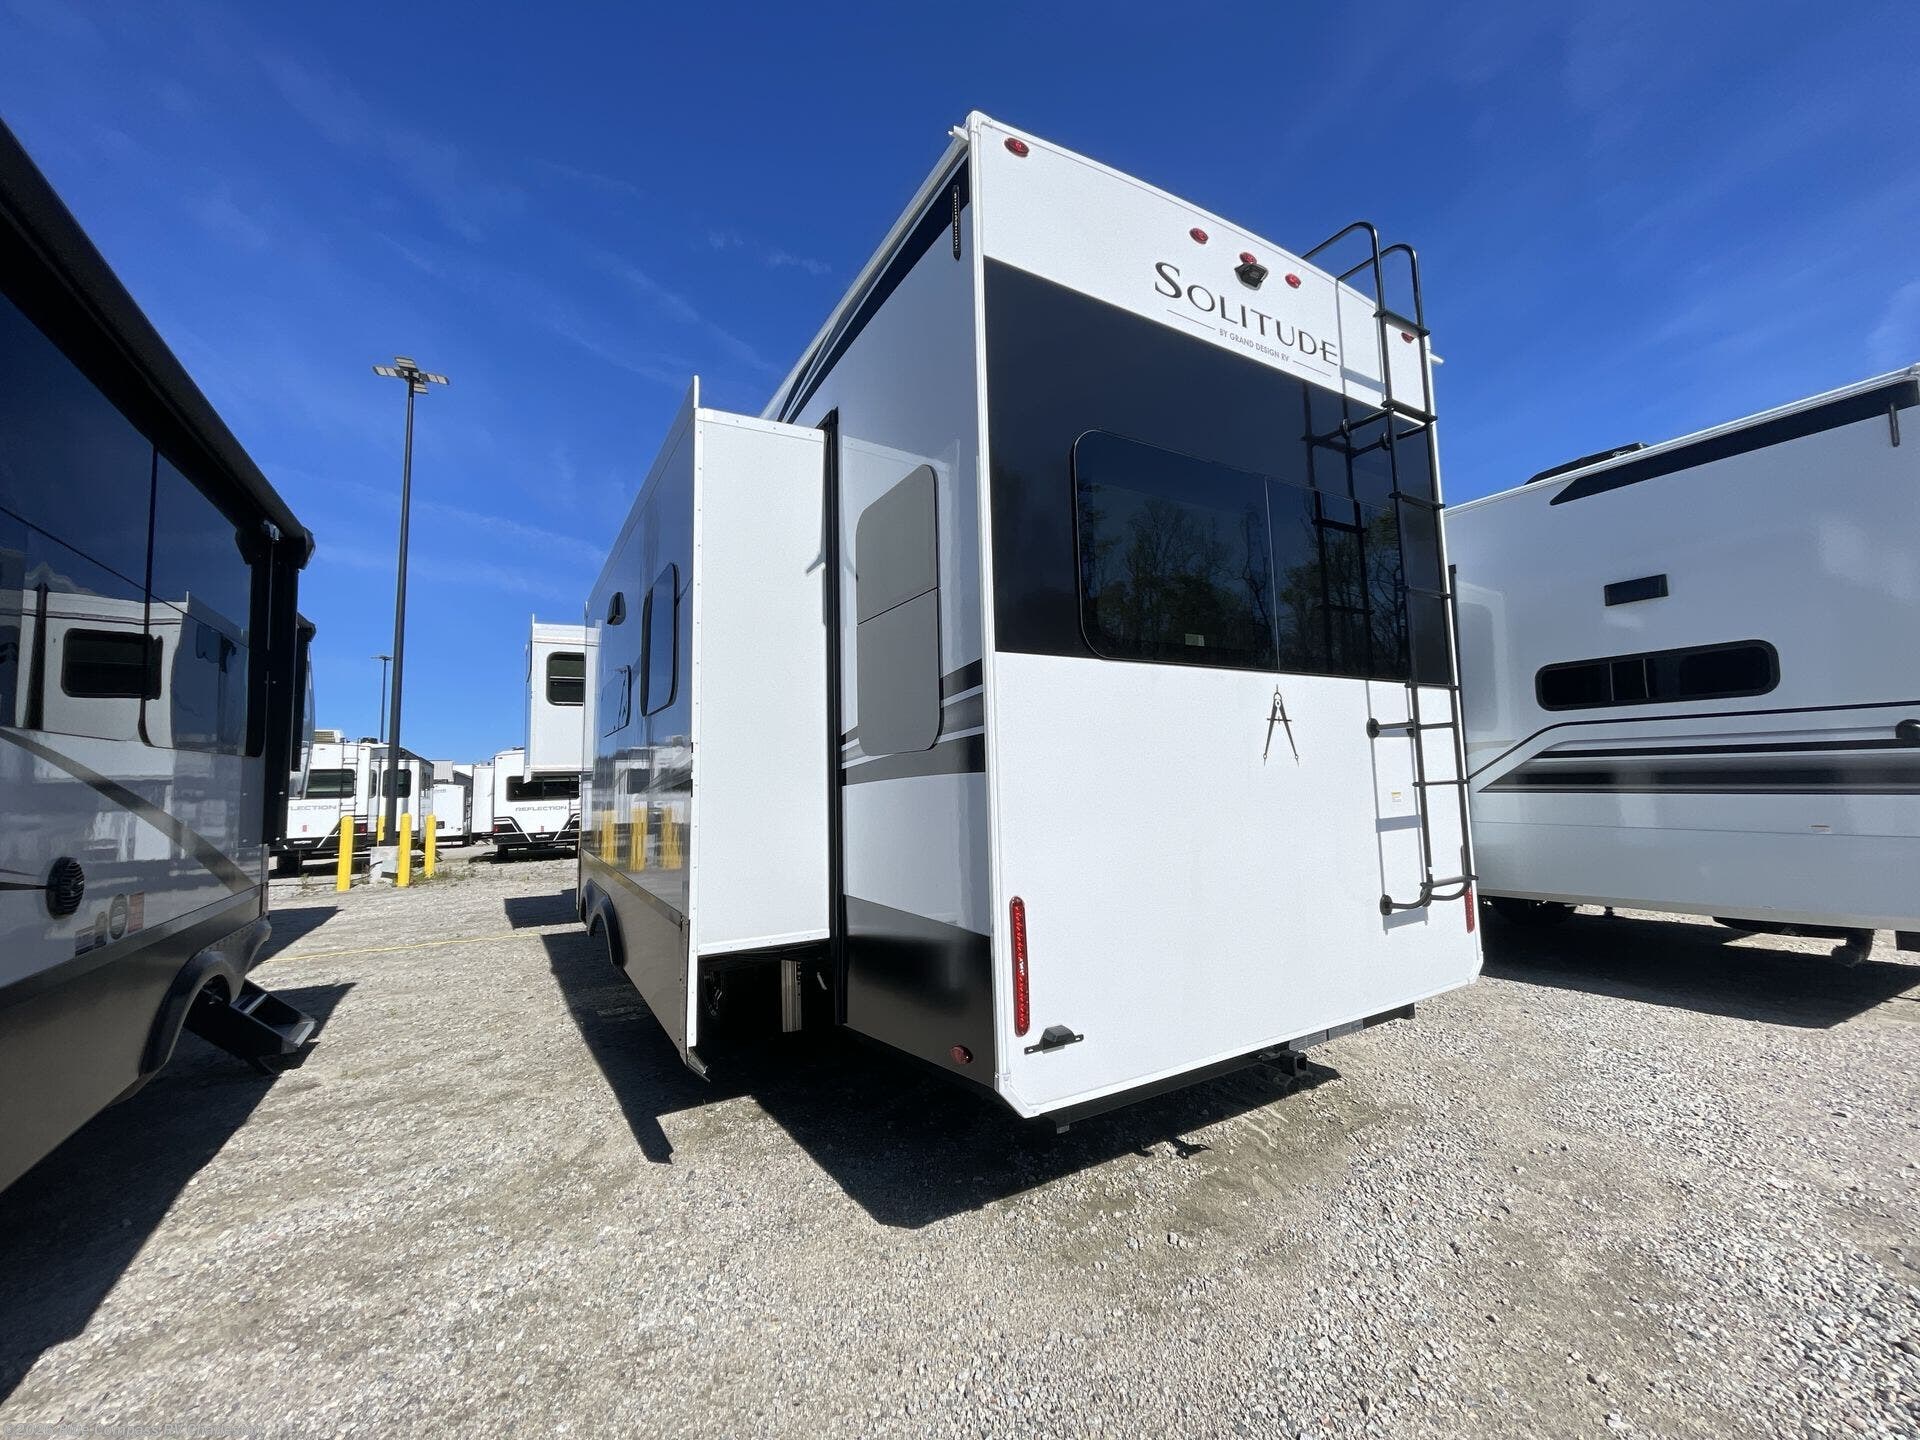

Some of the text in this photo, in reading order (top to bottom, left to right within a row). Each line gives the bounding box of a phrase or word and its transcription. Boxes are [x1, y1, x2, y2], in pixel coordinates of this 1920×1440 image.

[1155, 261, 1339, 366] SOLITUDE
[1219, 328, 1289, 361] BY GRAND DESIGN RV
